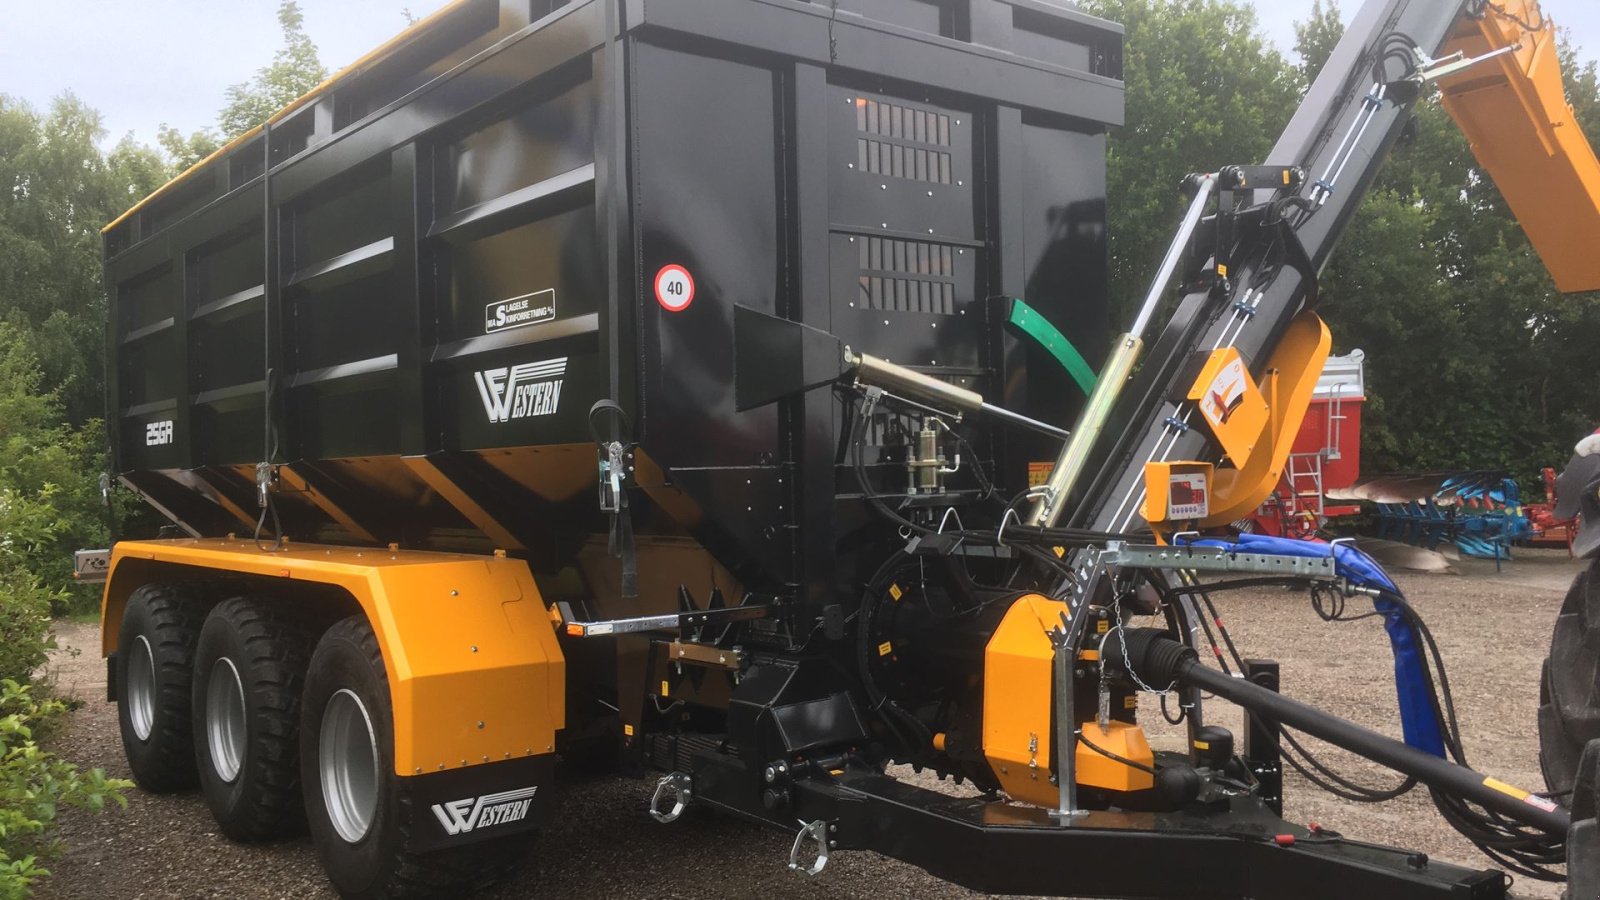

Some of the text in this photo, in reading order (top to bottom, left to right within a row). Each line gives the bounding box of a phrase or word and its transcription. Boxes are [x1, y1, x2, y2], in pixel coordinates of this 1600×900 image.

[667, 280, 683, 296] 40
[474, 356, 568, 424] WESTERN
[430, 785, 538, 836] WESTERN
